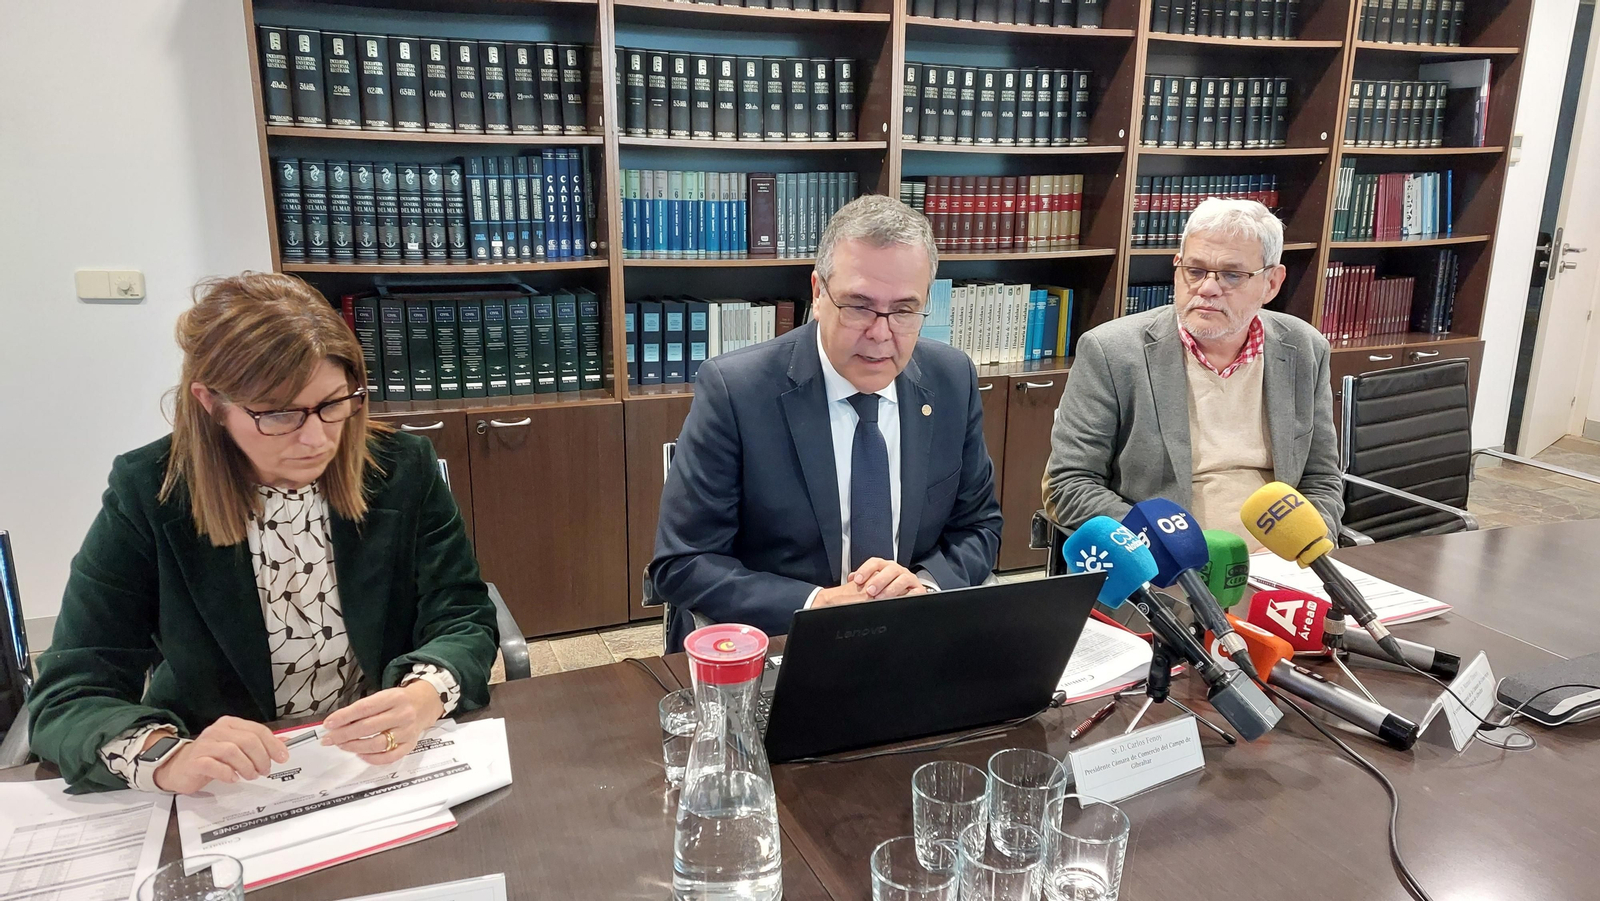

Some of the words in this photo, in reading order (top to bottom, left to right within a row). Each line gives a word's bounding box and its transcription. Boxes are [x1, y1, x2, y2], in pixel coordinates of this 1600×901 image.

[1257, 493, 1304, 535] SER
[835, 626, 887, 639] Lenovo
[1128, 740, 1145, 750] Carlos
[1146, 734, 1162, 744] Fenoy
[1085, 762, 1111, 776] Presidente
[1138, 747, 1160, 758] Comercio
[1169, 740, 1184, 748] Campo
[1130, 759, 1152, 769] Gibraltar
[270, 811, 288, 821] SUS
[290, 808, 303, 816] DE
[213, 817, 267, 836] FUNCIONES
